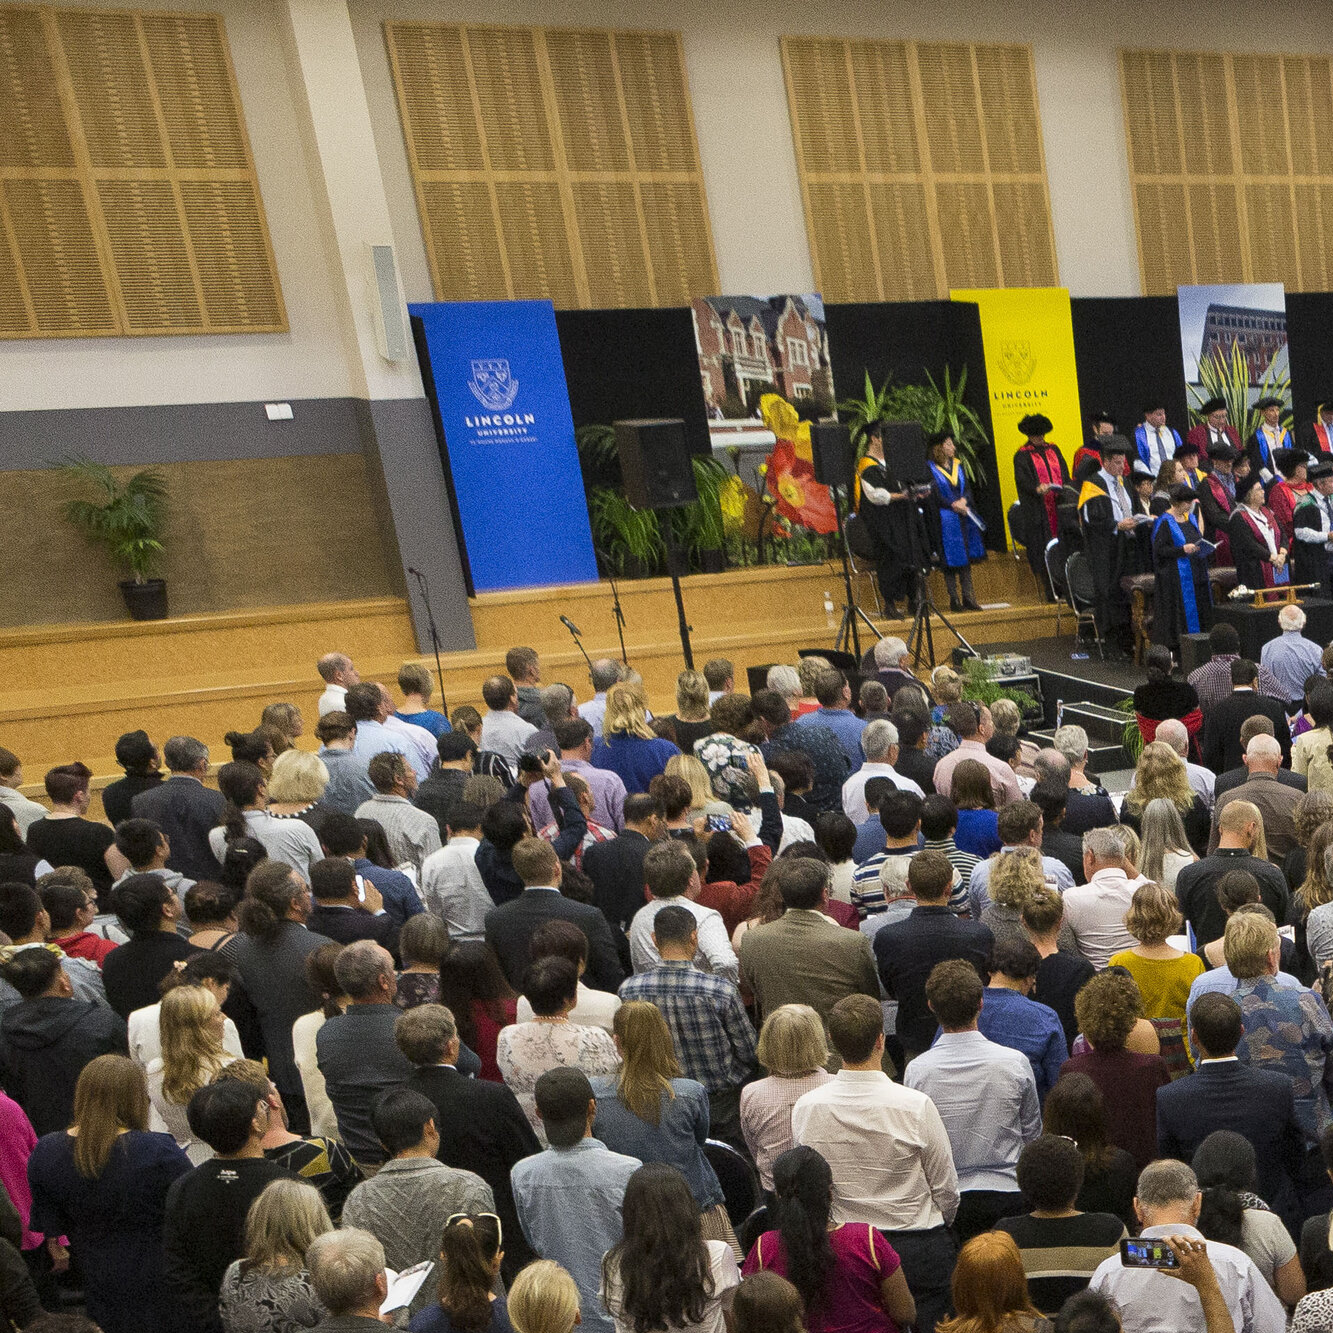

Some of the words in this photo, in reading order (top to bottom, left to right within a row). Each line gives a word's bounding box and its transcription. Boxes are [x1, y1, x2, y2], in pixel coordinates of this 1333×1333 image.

[994, 389, 1049, 400] LINCOLN
[465, 413, 535, 428] LINCOLN
[477, 427, 528, 437] UNIVERSITY
